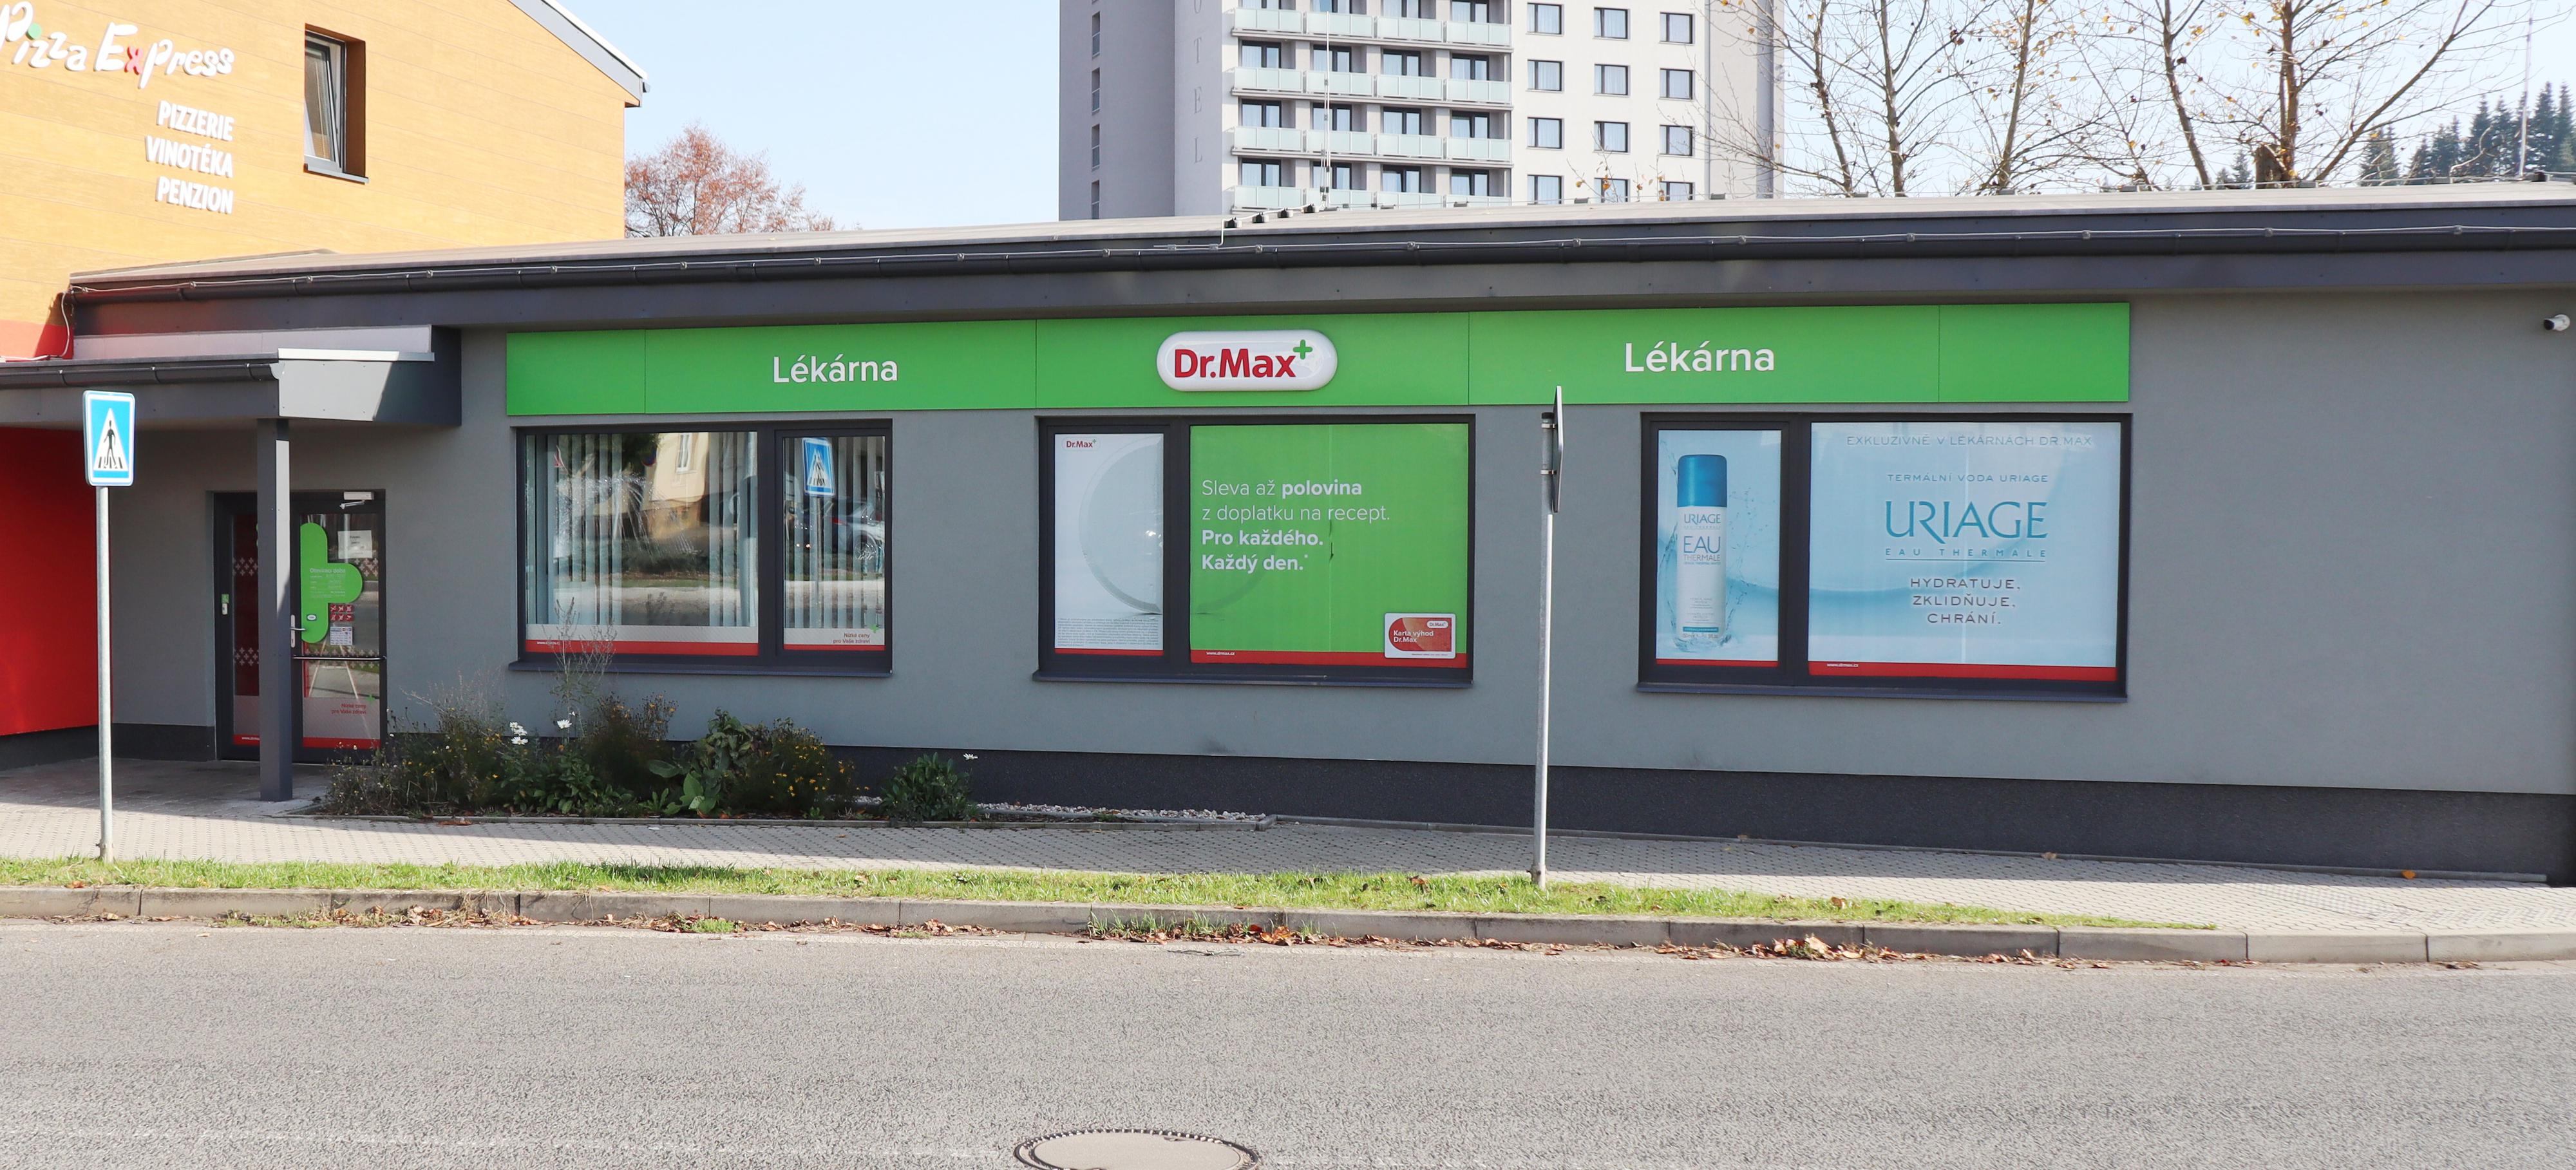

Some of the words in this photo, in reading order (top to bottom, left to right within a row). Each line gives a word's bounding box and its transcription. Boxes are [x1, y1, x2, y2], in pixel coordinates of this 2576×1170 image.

[0, 1, 88, 71] Pizza
[93, 22, 235, 90] Express
[156, 100, 234, 142] PIZZERIE
[145, 135, 234, 178] VINOTÉKA
[155, 176, 234, 214] PENZION
[1625, 340, 1775, 372] Lékárna
[773, 354, 898, 383] Lékárna
[1846, 434, 1931, 446] EXKLUZIVNĚ
[1937, 437, 1945, 445] V
[1949, 434, 2034, 446] LÉKÁRNÁCH
[1888, 473, 1953, 482] TERMÁLNÍ
[1202, 480, 1249, 495] Sleva
[1256, 480, 1275, 495] až
[1282, 479, 1362, 499] polovina
[1202, 509, 1211, 520] z
[1217, 505, 1294, 524] doplatku
[1300, 509, 1321, 520] na
[1328, 506, 1390, 524] recept.
[1684, 514, 1721, 525] URIAGE
[1886, 500, 2049, 544] URIAGE
[1202, 530, 1233, 545] Pro
[1239, 529, 1323, 545] každého.
[1683, 536, 1721, 554] EAU
[1940, 549, 2046, 558] THERMALE
[1202, 554, 1258, 574] Každý
[1911, 578, 2020, 590] HYDRATUJE,
[1913, 594, 2016, 608] ZKLIDŇUJE,
[1927, 612, 2001, 625] CHRÁNÍ.
